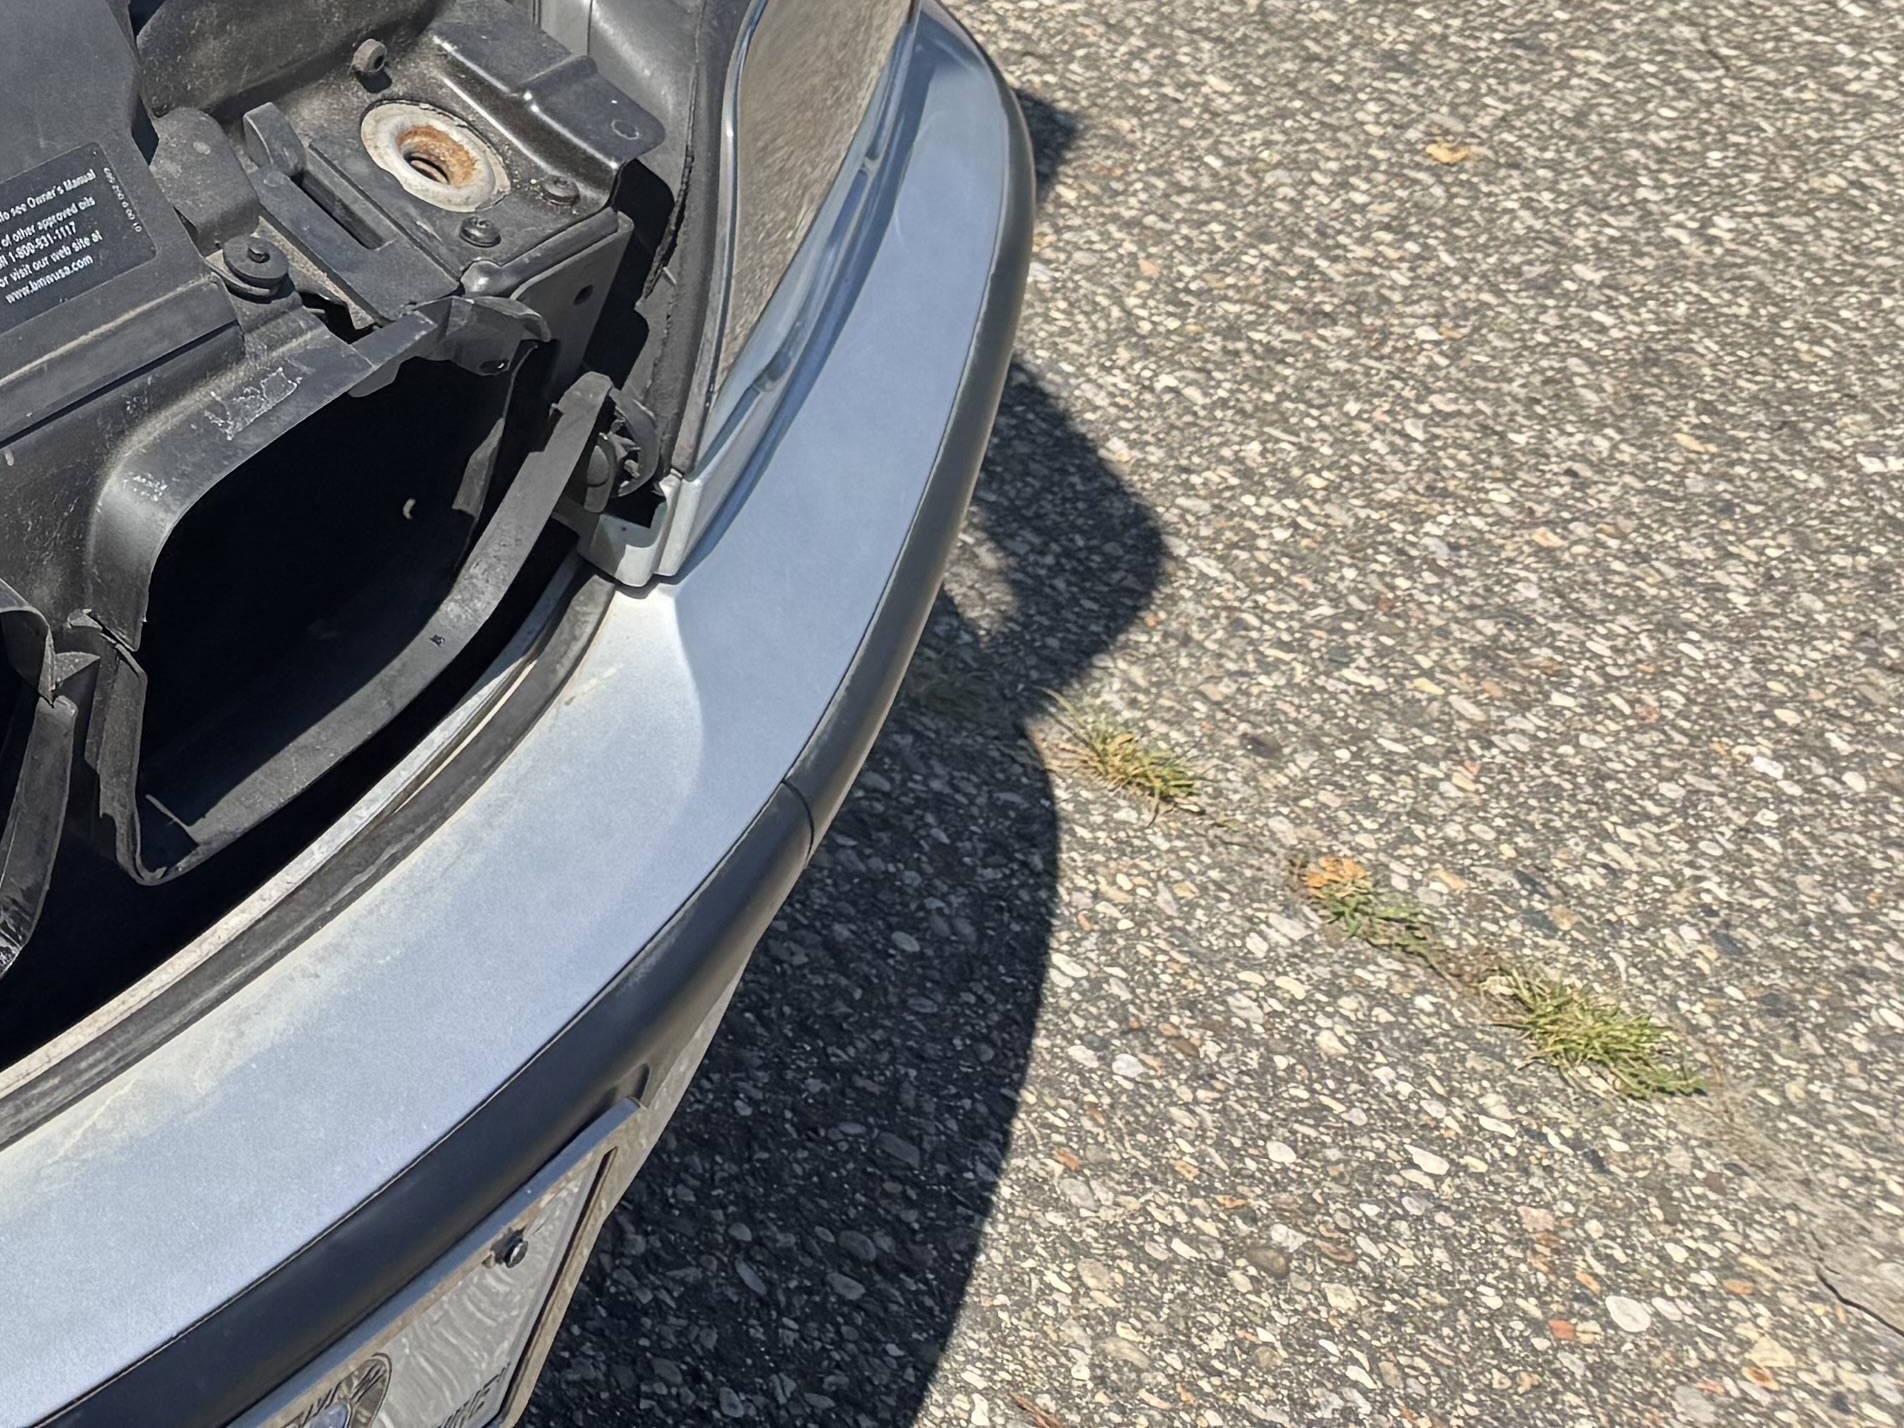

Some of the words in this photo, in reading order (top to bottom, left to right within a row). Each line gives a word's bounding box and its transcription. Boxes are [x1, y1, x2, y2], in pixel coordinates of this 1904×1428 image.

[10, 204, 27, 217] see
[27, 186, 64, 208] Owner's
[63, 168, 96, 191] Manual
[0, 234, 12, 248] of
[11, 225, 36, 242] other
[37, 202, 78, 230] approved
[77, 195, 96, 210] oils
[5, 254, 94, 304] www.bmwusa.com
[9, 263, 33, 282] visit
[32, 255, 50, 271] our
[50, 245, 72, 263] web
[71, 237, 91, 252] site
[91, 229, 103, 243] at
